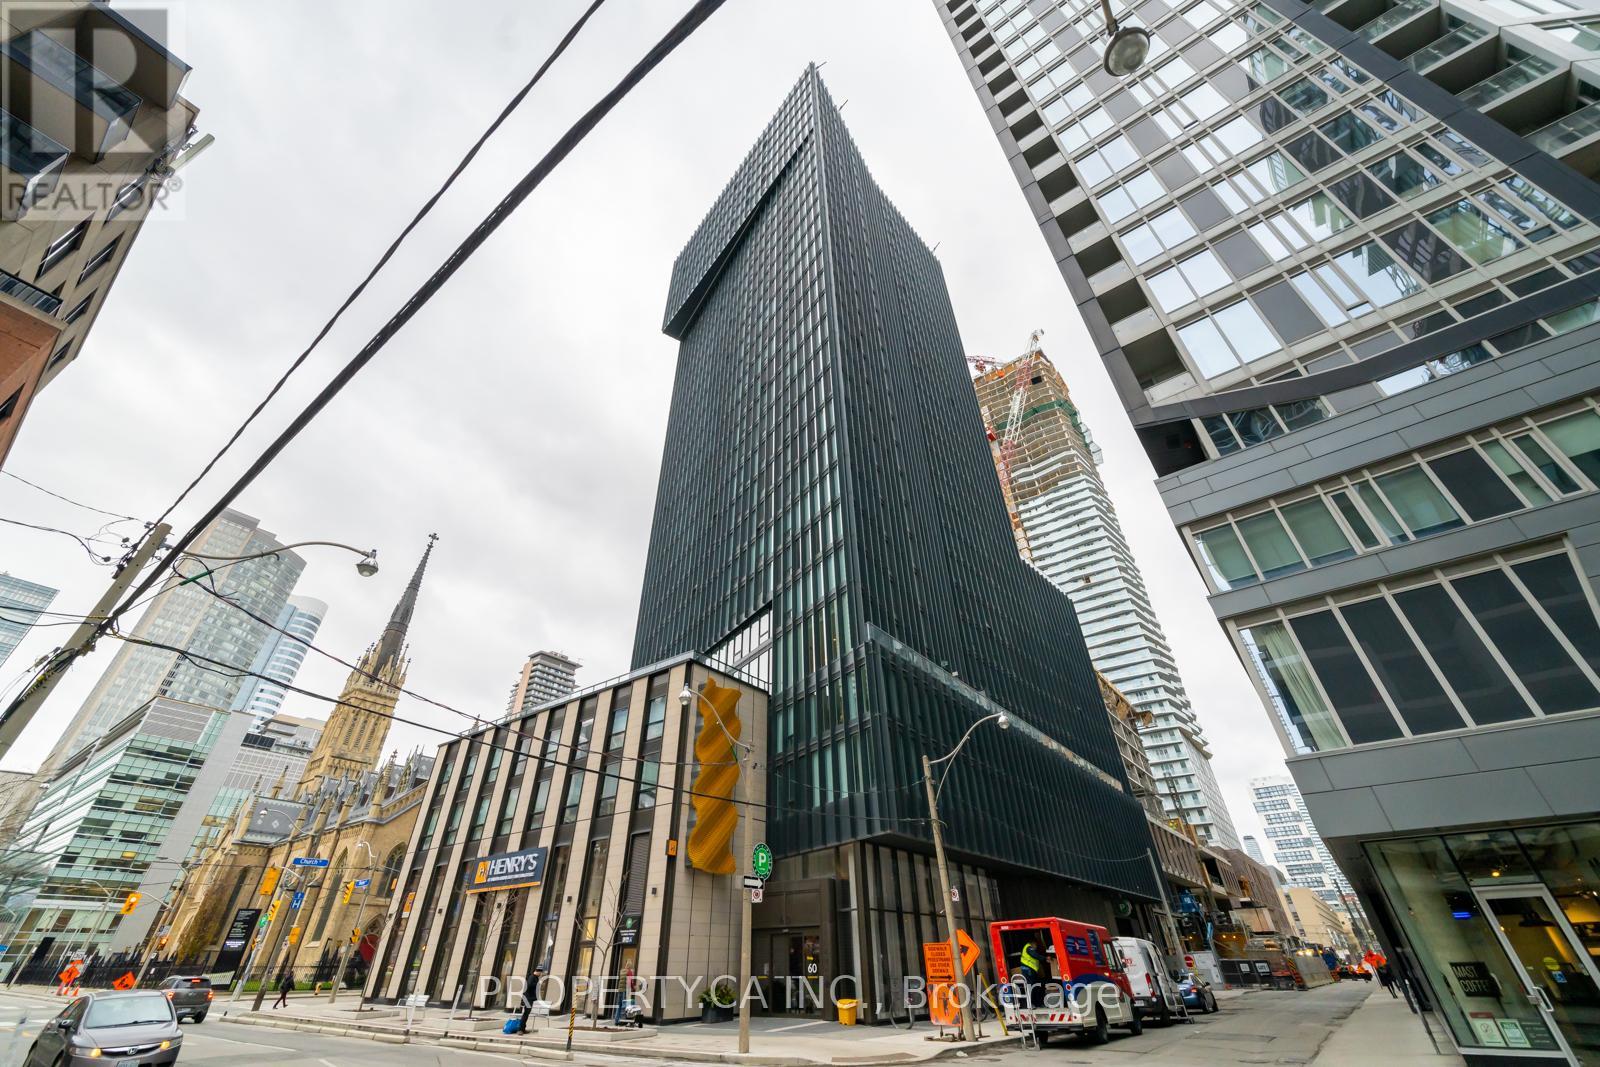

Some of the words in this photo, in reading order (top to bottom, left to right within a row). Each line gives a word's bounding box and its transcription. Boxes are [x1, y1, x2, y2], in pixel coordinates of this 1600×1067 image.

[299, 858, 319, 866] Church
[489, 853, 539, 876] HENRY'S
[758, 852, 767, 867] P
[807, 963, 818, 974] 60
[1452, 965, 1479, 978] MAST
